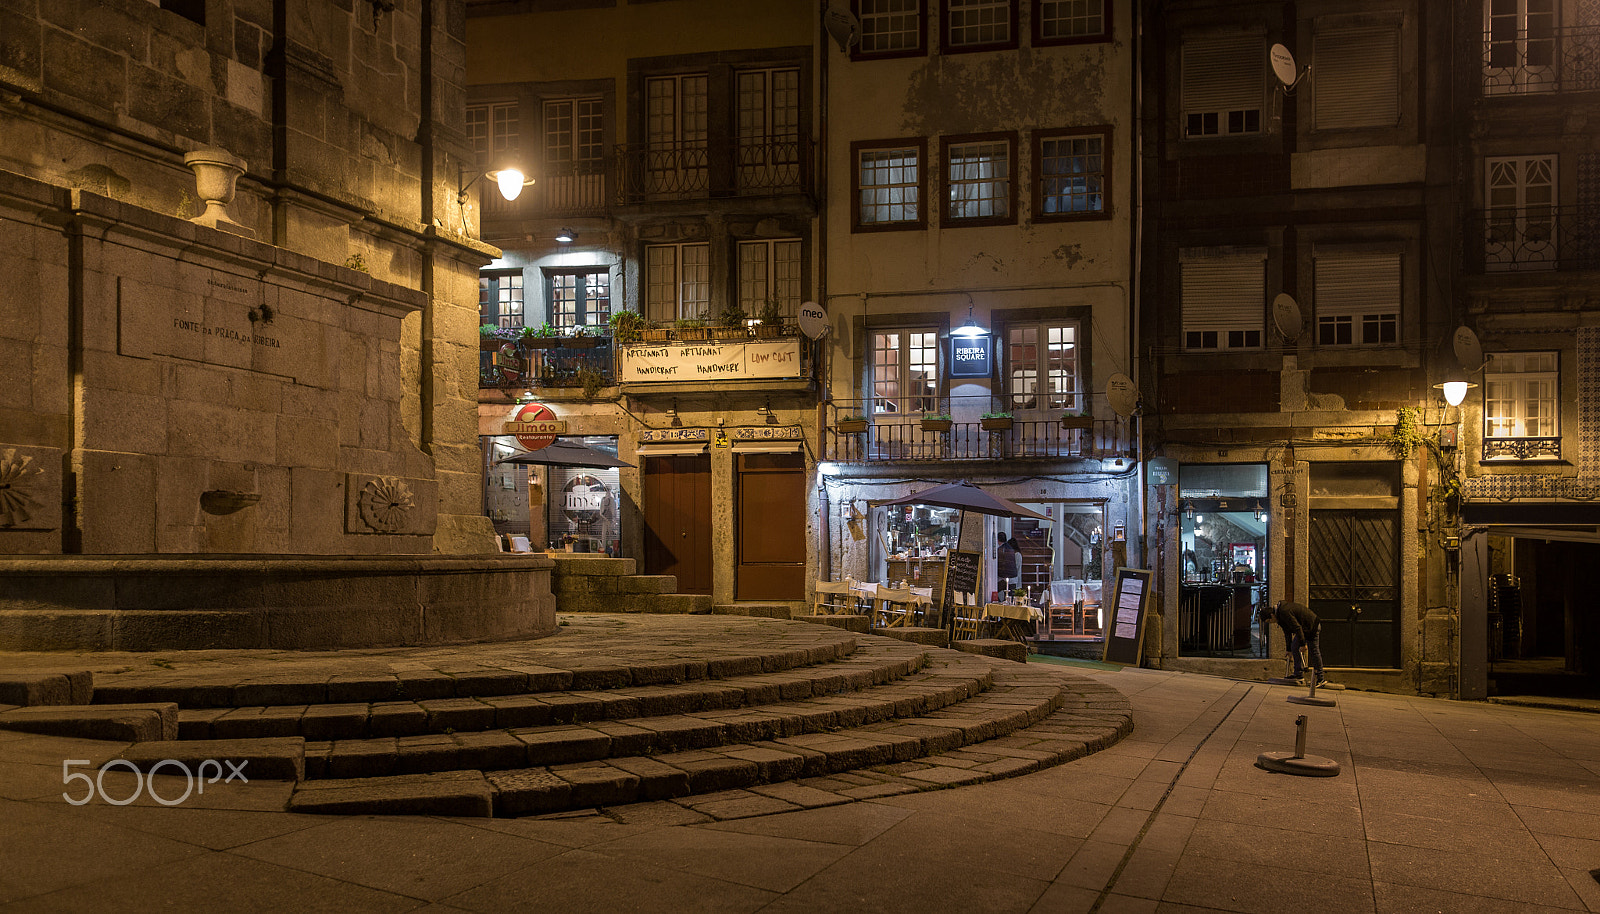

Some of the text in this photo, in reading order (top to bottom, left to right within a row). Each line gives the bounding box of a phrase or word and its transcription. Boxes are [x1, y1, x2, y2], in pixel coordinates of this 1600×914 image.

[802, 309, 823, 319] meo
[173, 319, 200, 333] FONTE
[254, 335, 281, 348] RIBEIRA
[752, 351, 796, 364] LOW COST
[636, 366, 679, 375] HANDICRAFT
